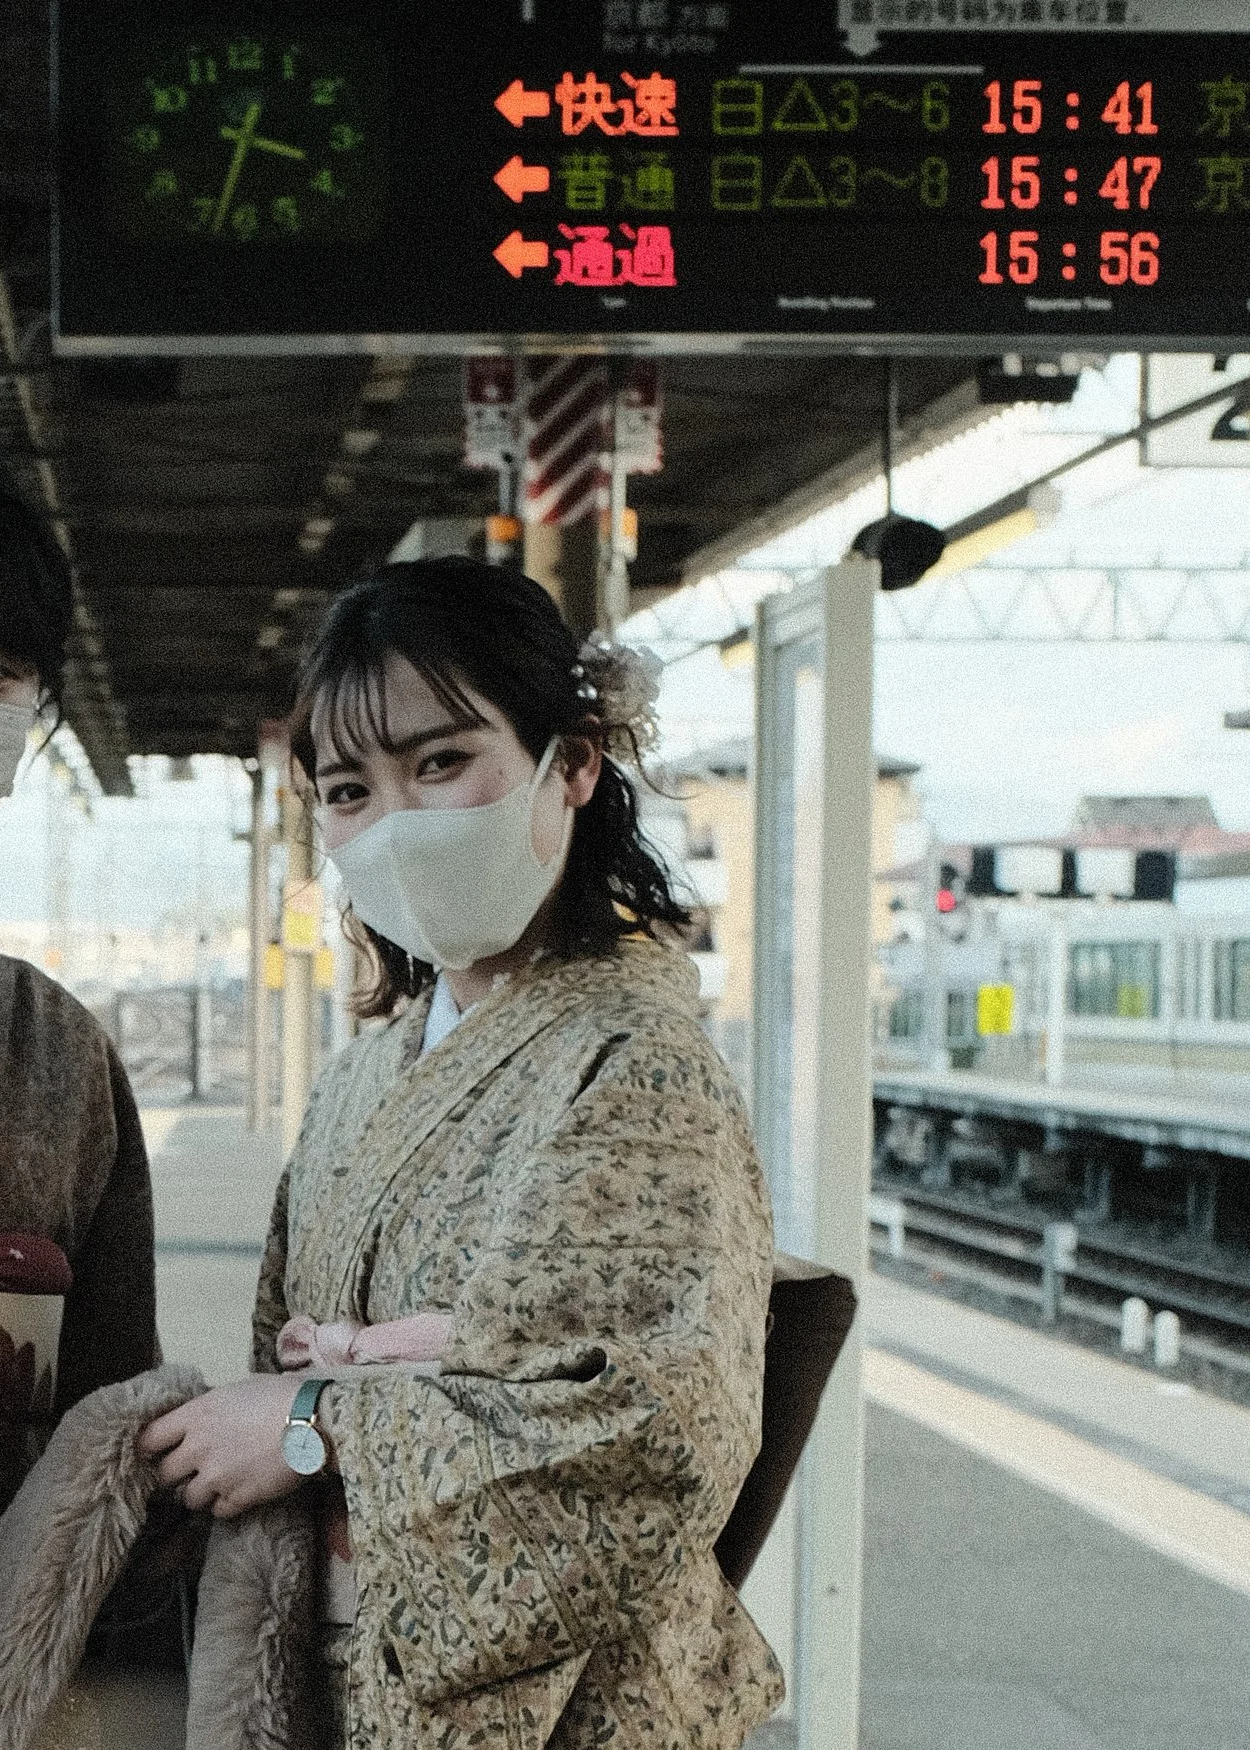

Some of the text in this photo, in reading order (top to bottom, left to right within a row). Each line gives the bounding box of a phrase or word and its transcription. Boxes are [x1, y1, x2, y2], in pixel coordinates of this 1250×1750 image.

[555, 71, 679, 136] 快速
[982, 80, 1159, 134] 15:41
[558, 152, 675, 210] 普通
[980, 155, 1162, 210] 15:47
[553, 222, 1160, 287] 通過 15:56
